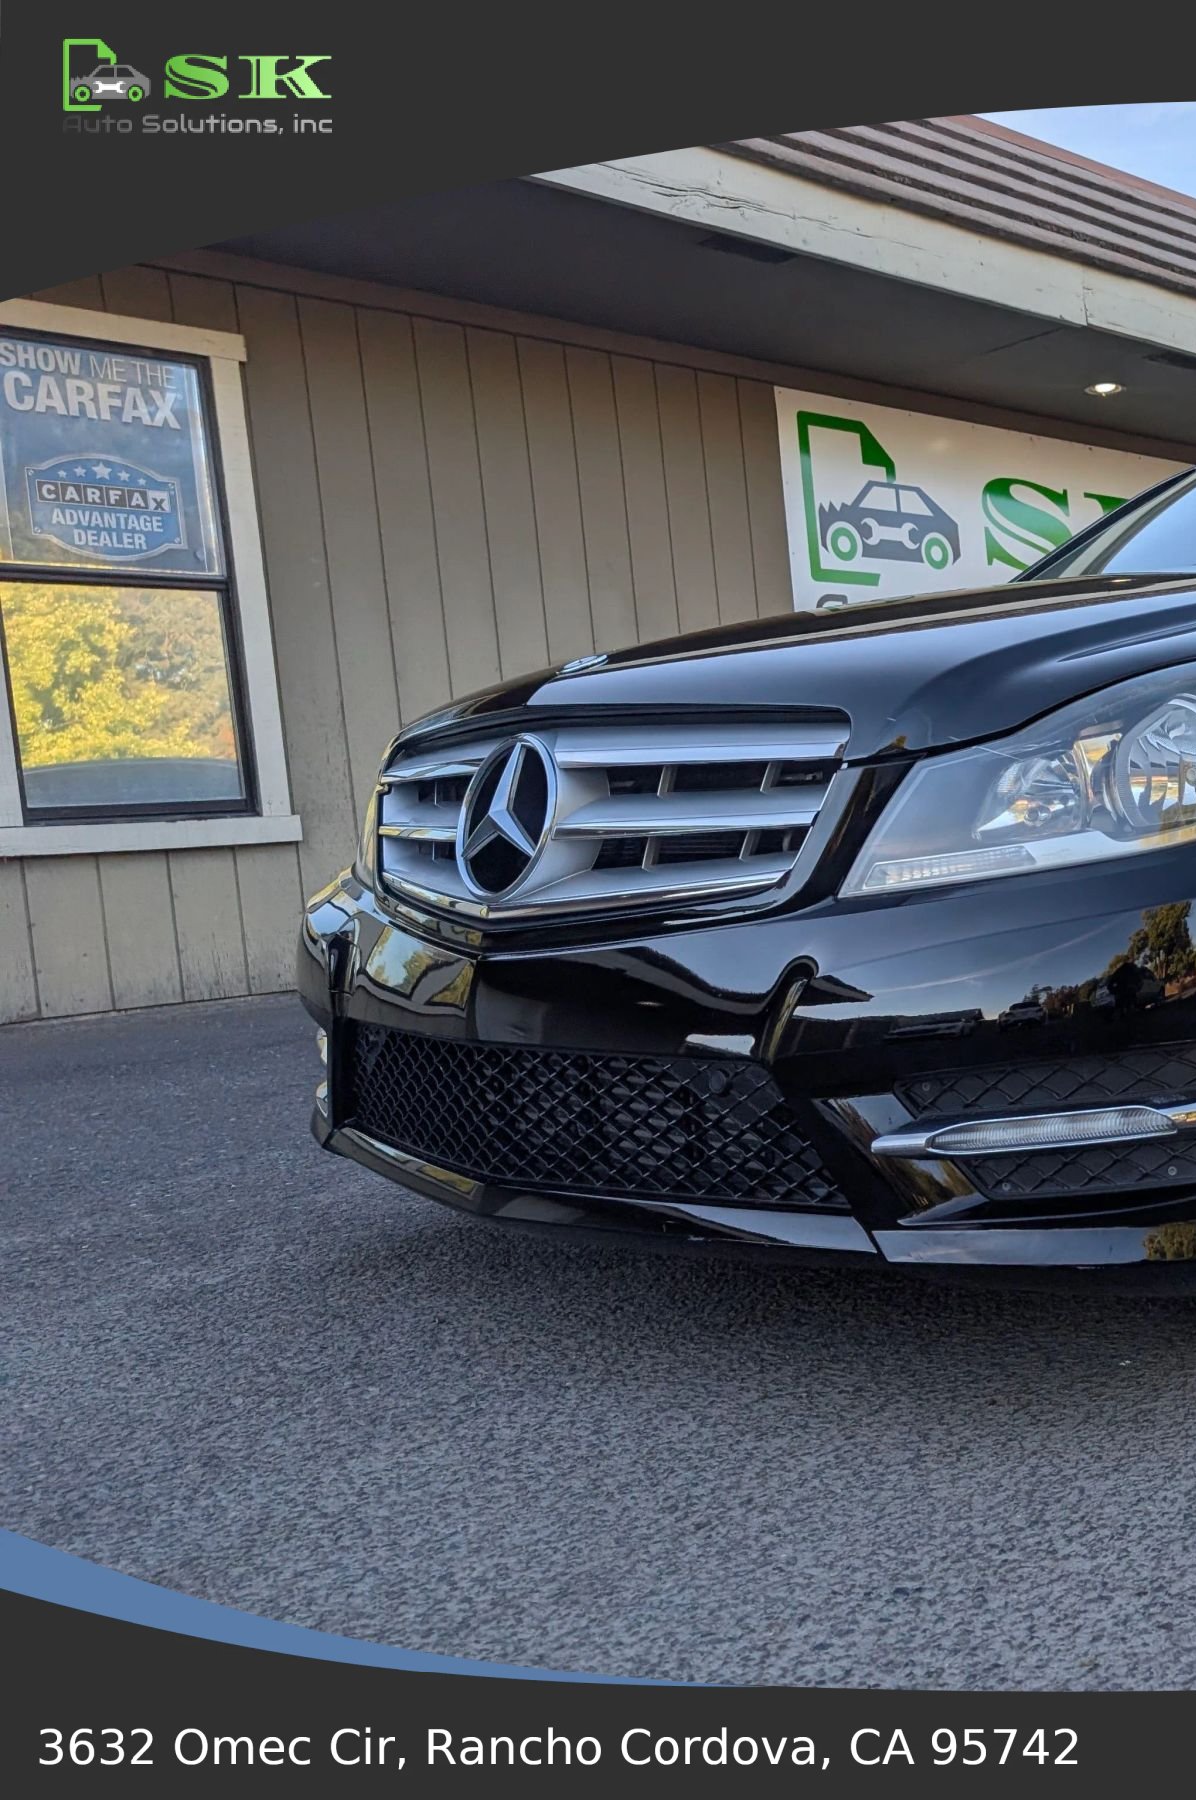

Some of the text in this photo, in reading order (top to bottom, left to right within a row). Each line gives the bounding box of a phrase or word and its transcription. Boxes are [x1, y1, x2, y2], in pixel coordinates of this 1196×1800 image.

[0, 343, 177, 390] SHOW ME THE
[3, 371, 181, 430] CARFAX
[41, 483, 168, 511] CARFAX
[52, 509, 163, 532] ADVANTAGE
[74, 529, 147, 550] DEALER
